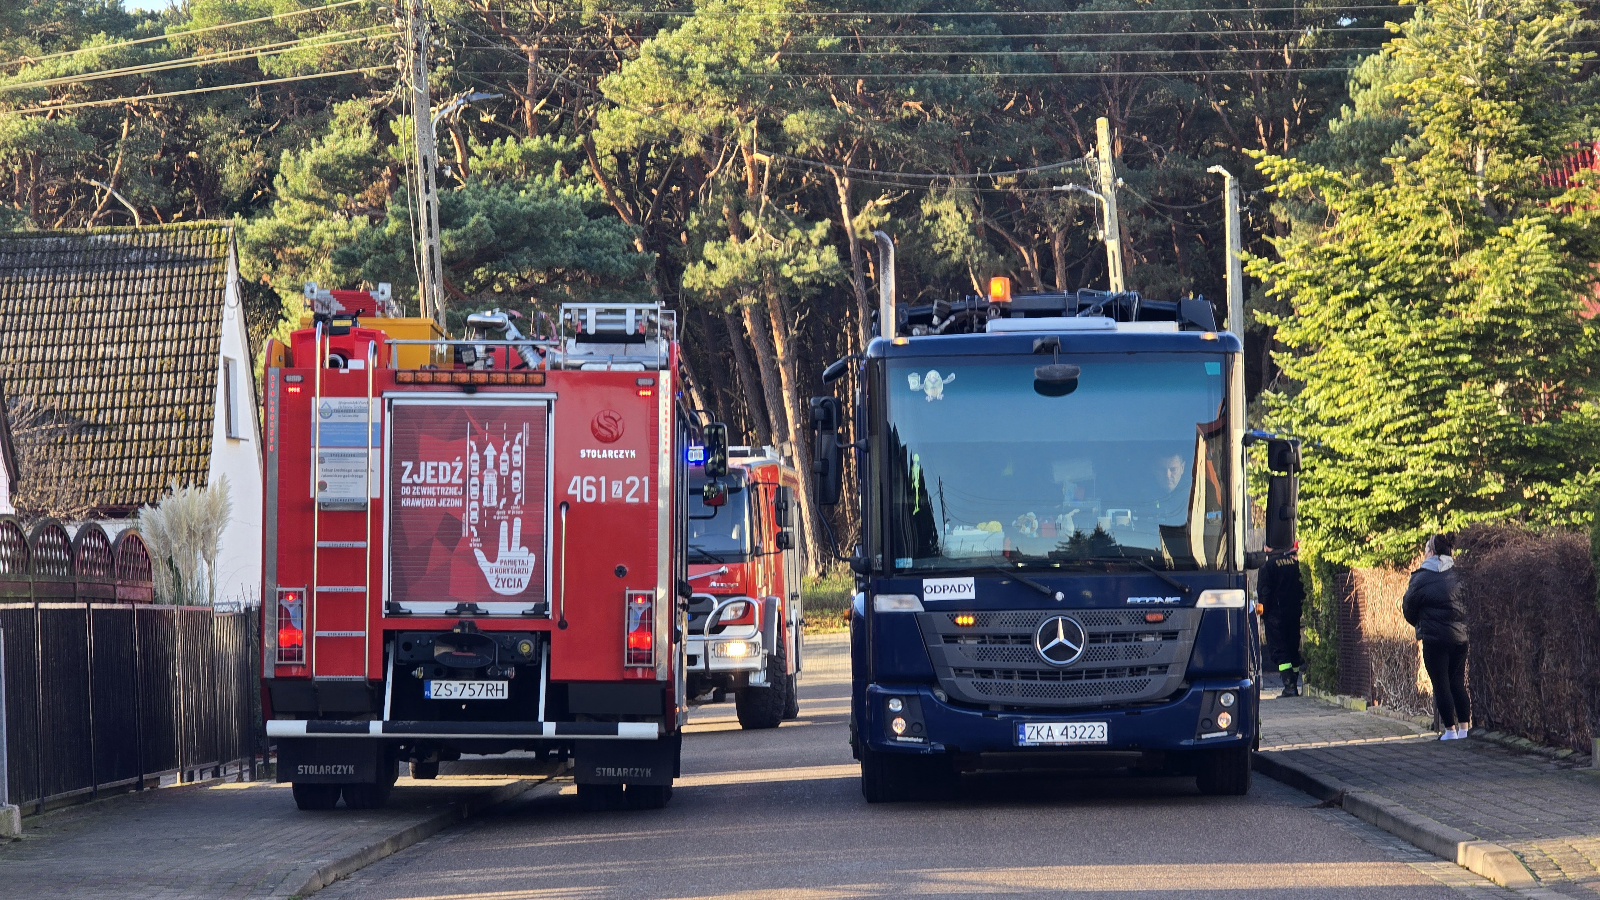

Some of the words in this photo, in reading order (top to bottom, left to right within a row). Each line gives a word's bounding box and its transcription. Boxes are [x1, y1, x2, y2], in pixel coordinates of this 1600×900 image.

[580, 449, 636, 459] STOLARCZYK
[401, 456, 463, 484] ZJEDŹ
[401, 486, 411, 496] DO
[412, 486, 463, 497] ZEWNĘTRZNEJ
[568, 475, 607, 503] 461
[625, 475, 649, 503] 21
[401, 497, 436, 509] KRAWĘDZI
[437, 497, 463, 507] JEZDNI
[499, 558, 529, 567] PAMIĘTAJ
[489, 567, 494, 575] O
[494, 567, 529, 575] KORYTARZU
[494, 574, 523, 589] ŻYCIA
[924, 582, 973, 594] ODPADY
[1126, 596, 1181, 605] ECONIC
[433, 682, 453, 697] ZS
[458, 682, 506, 697] 757RH
[1026, 725, 1055, 740] ZKA
[1060, 724, 1105, 740] 43223
[297, 764, 354, 775] STOLARCZYK
[595, 767, 652, 778] STOLARCZYK
